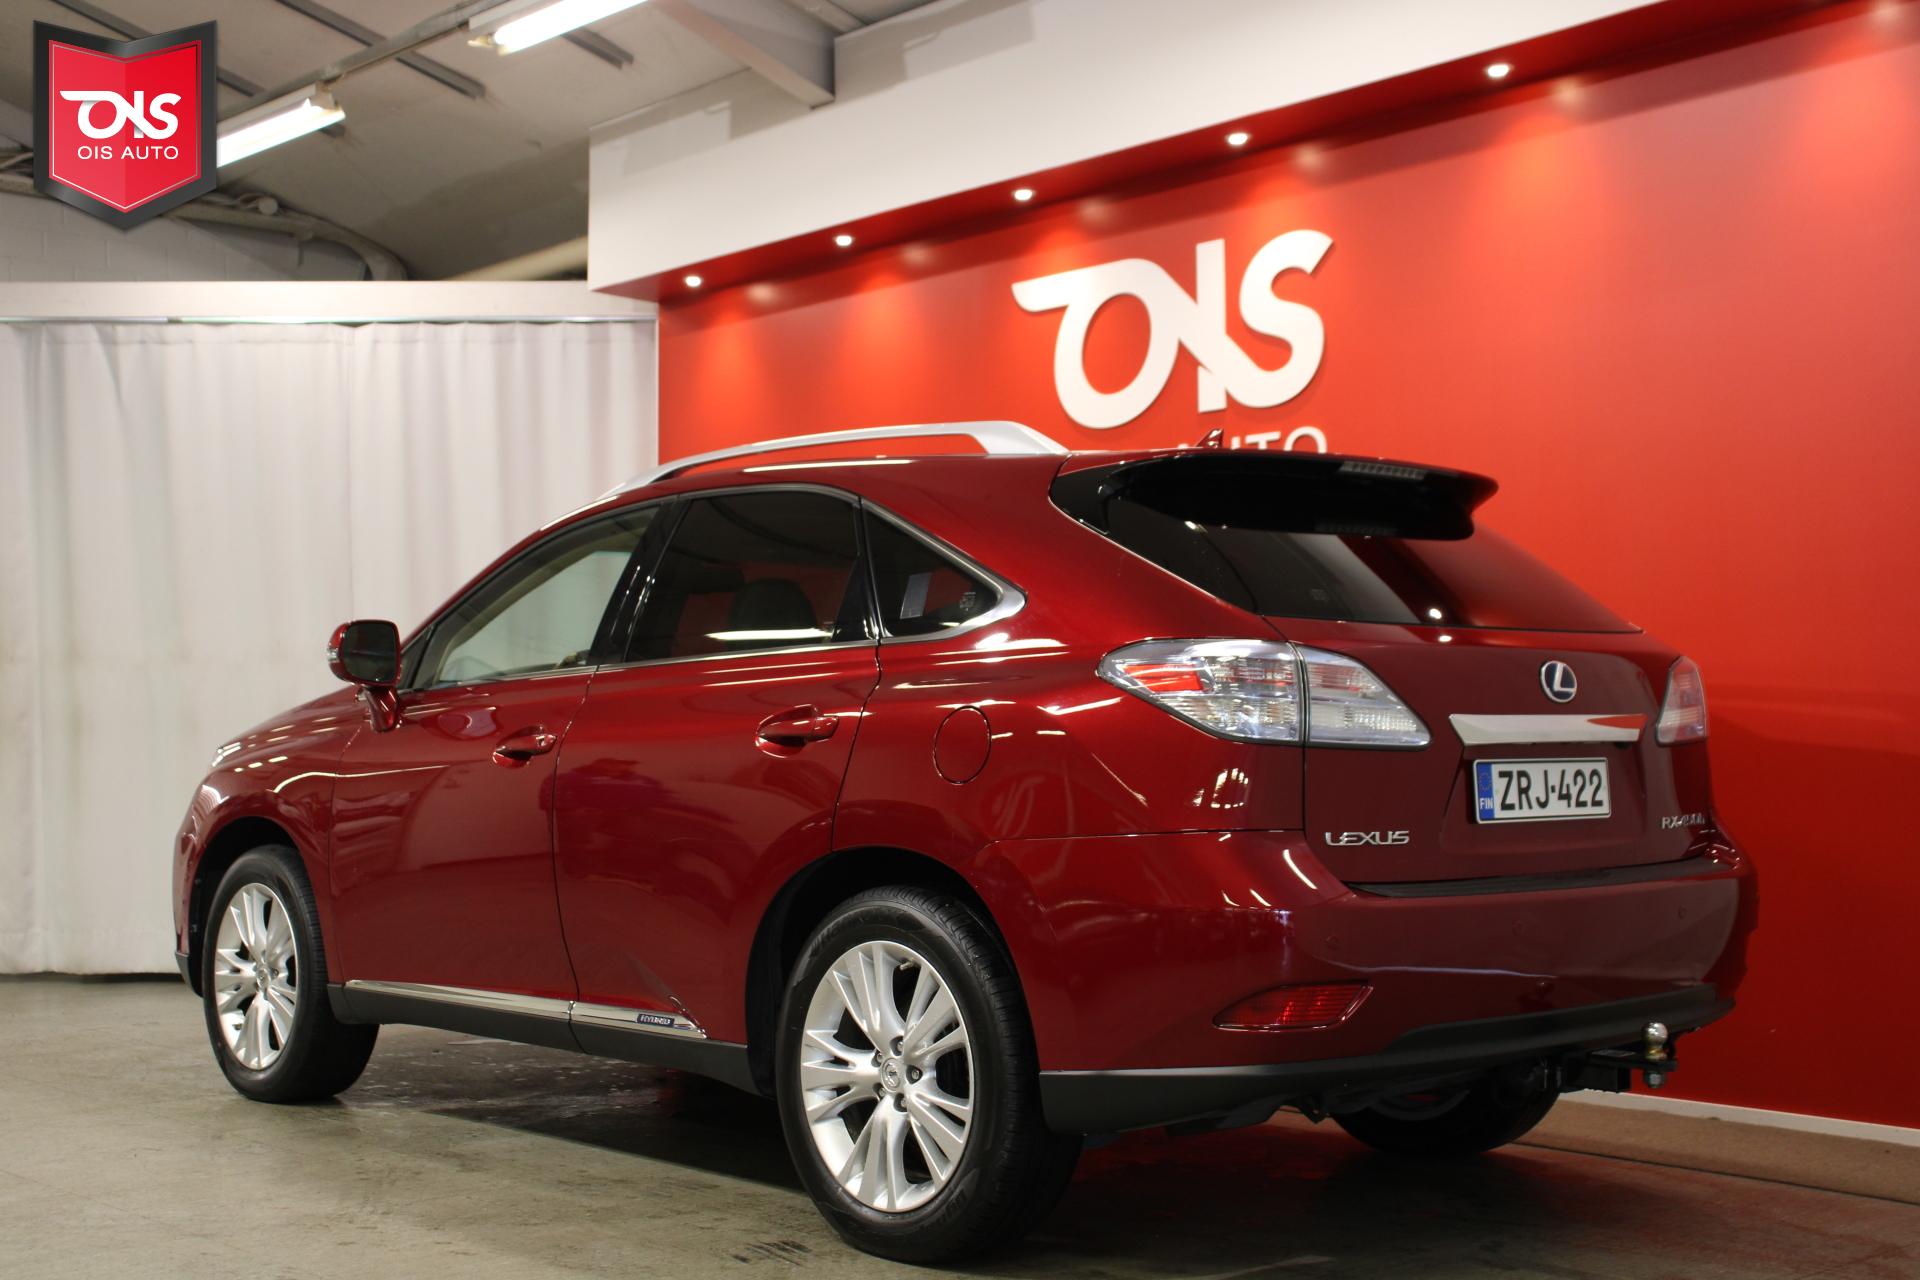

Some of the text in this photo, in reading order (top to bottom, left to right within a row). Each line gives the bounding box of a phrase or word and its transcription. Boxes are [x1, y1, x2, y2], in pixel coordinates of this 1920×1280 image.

[1011, 229, 1334, 429] OIS
[1479, 797, 1494, 810] FIN
[1498, 768, 1604, 811] ZRJ-422
[1325, 830, 1410, 846] LEXUS
